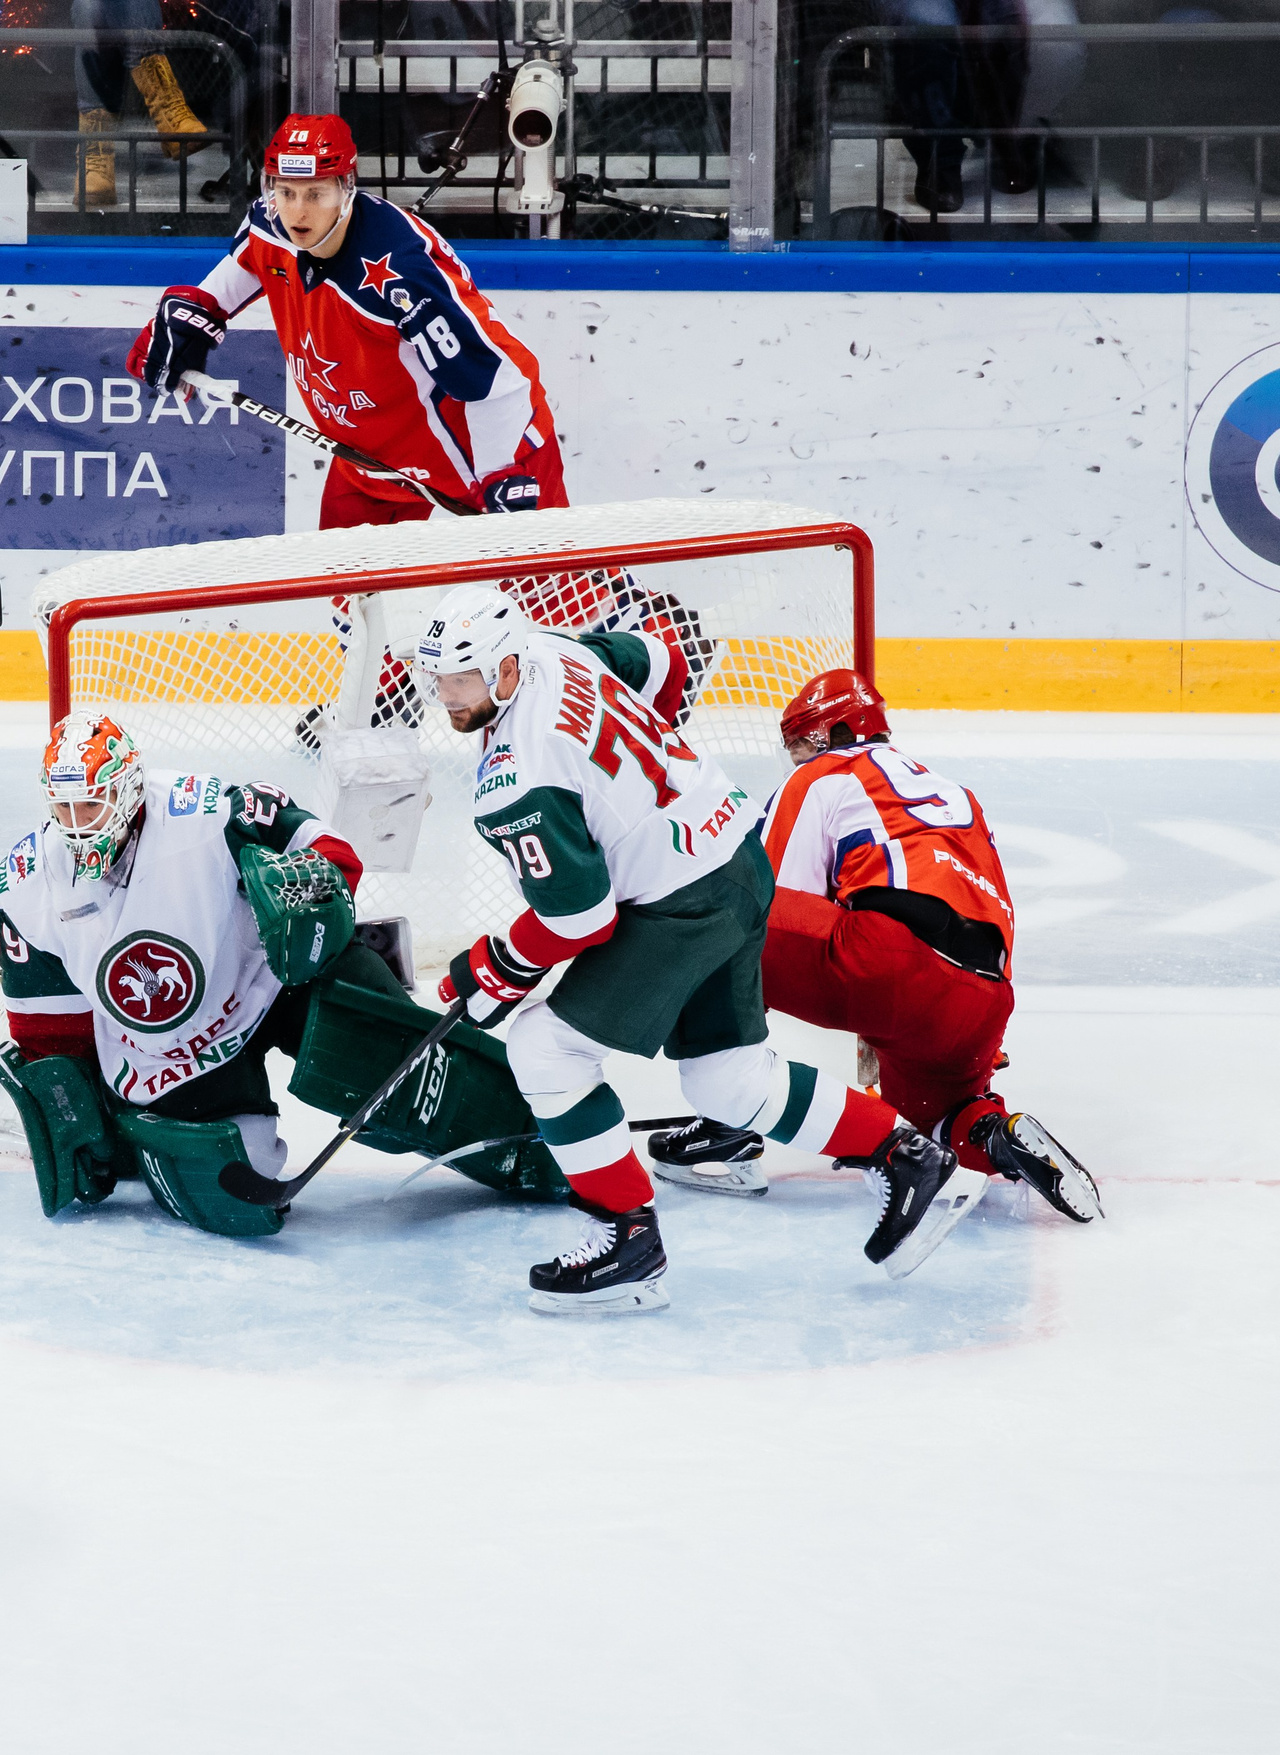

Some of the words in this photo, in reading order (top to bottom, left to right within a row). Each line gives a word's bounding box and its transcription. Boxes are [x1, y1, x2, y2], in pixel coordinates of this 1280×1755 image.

[410, 315, 461, 371] 78
[238, 398, 339, 453] BAUER
[426, 619, 446, 639] 79
[588, 673, 700, 809] 79
[51, 765, 85, 773] СОГАЗ
[475, 772, 518, 804] KAZAN
[418, 1042, 446, 1125] CCM
